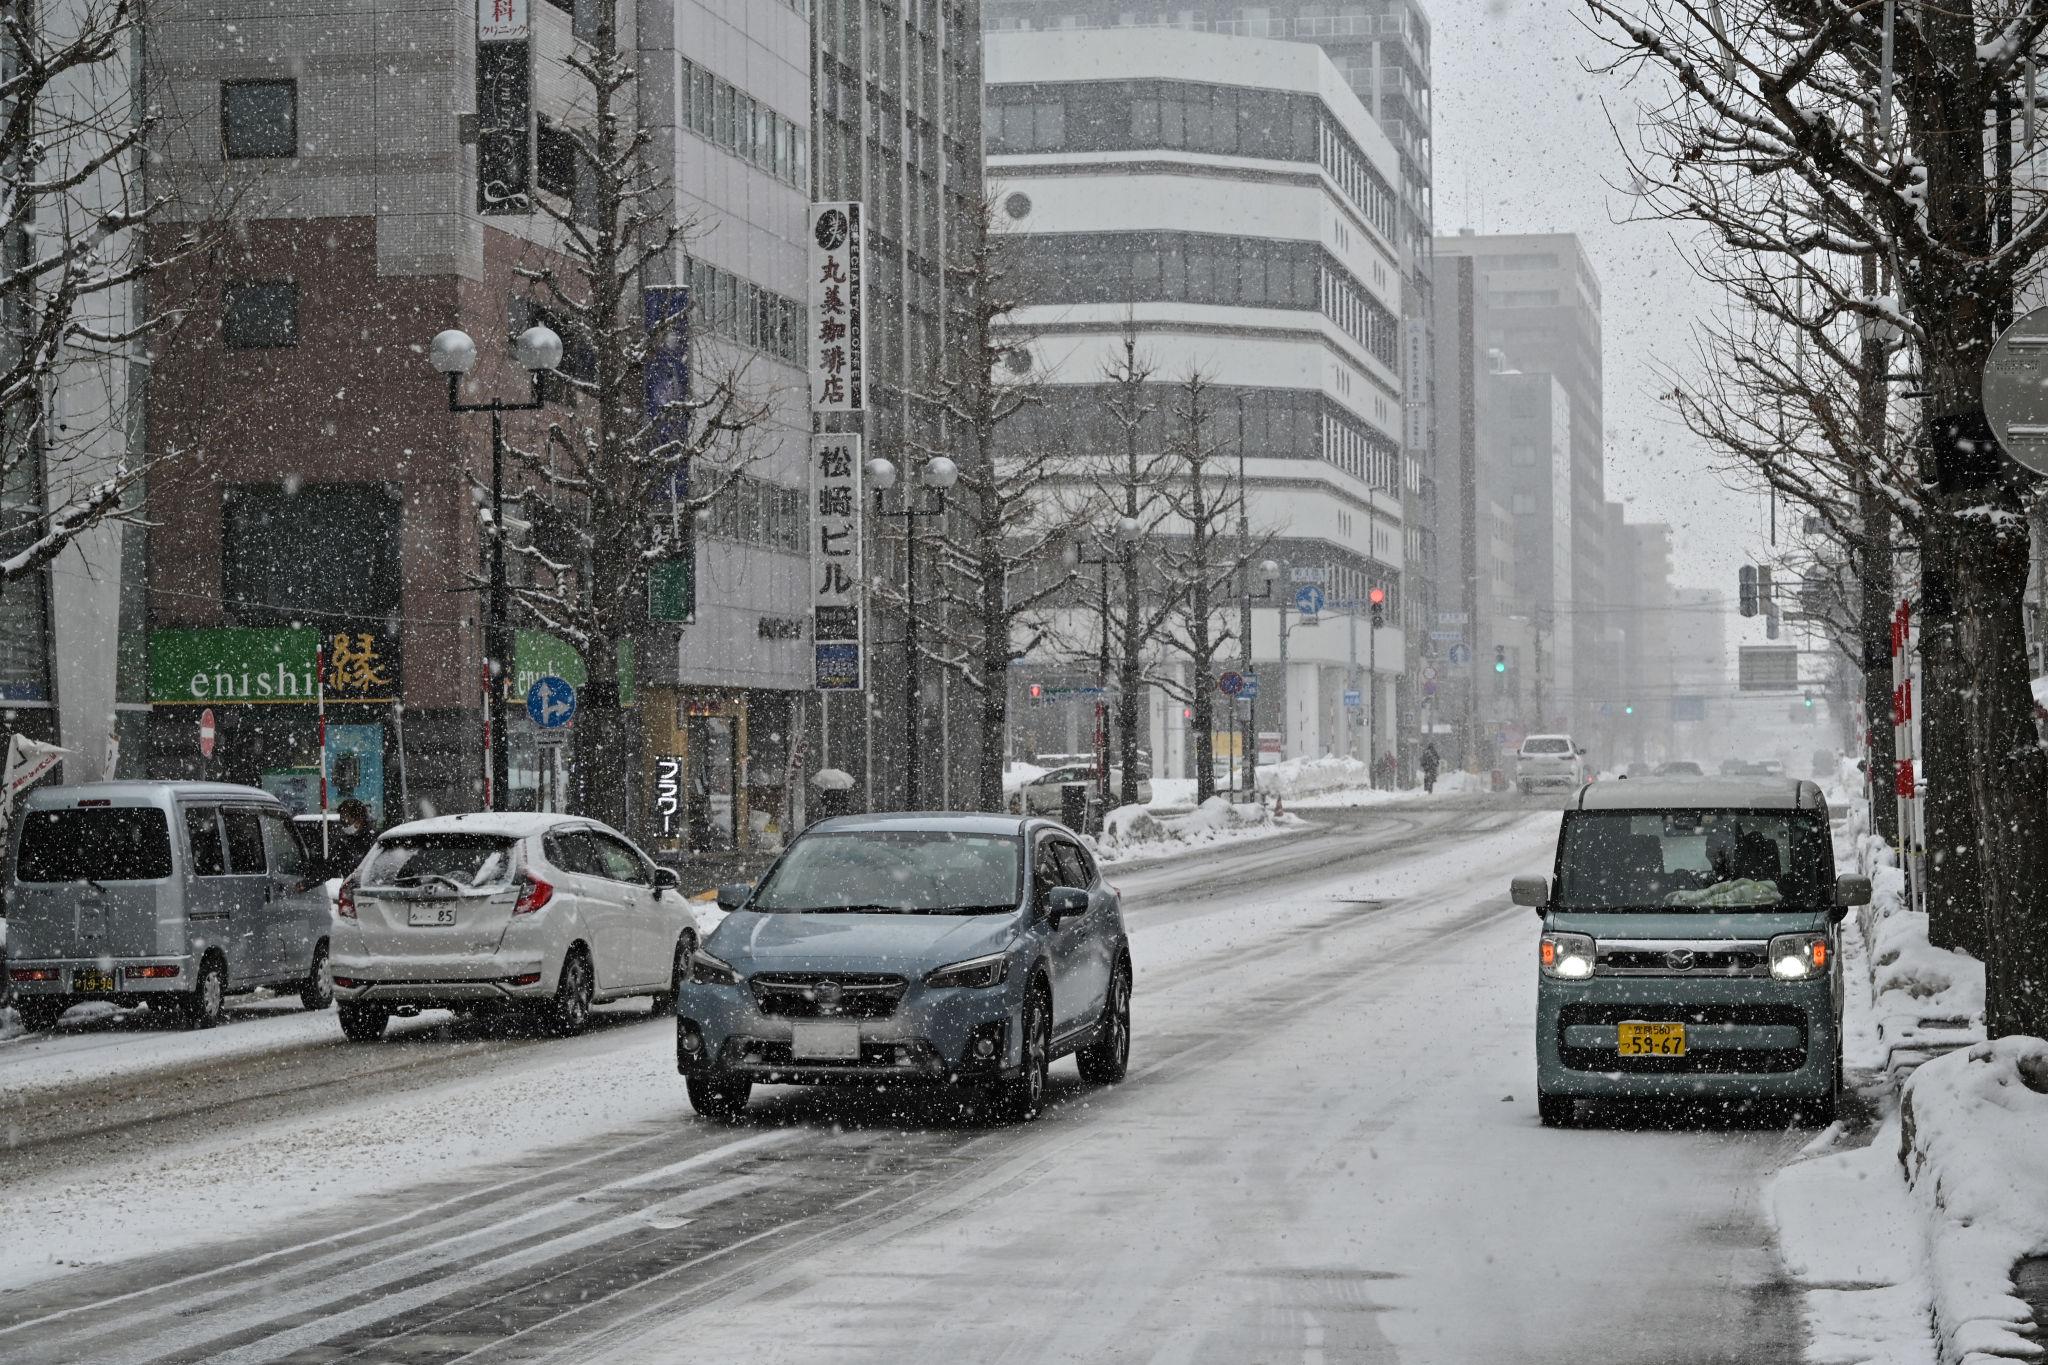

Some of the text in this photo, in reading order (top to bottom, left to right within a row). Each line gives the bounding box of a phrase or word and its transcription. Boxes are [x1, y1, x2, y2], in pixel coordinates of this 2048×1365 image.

[481, 25, 527, 37] クリニック
[819, 255, 846, 404] 丸美珈琲店
[190, 662, 316, 697] enishi
[329, 632, 393, 691] 縁
[658, 761, 678, 832] フラワー
[1632, 1036, 1682, 1054] 59-67
